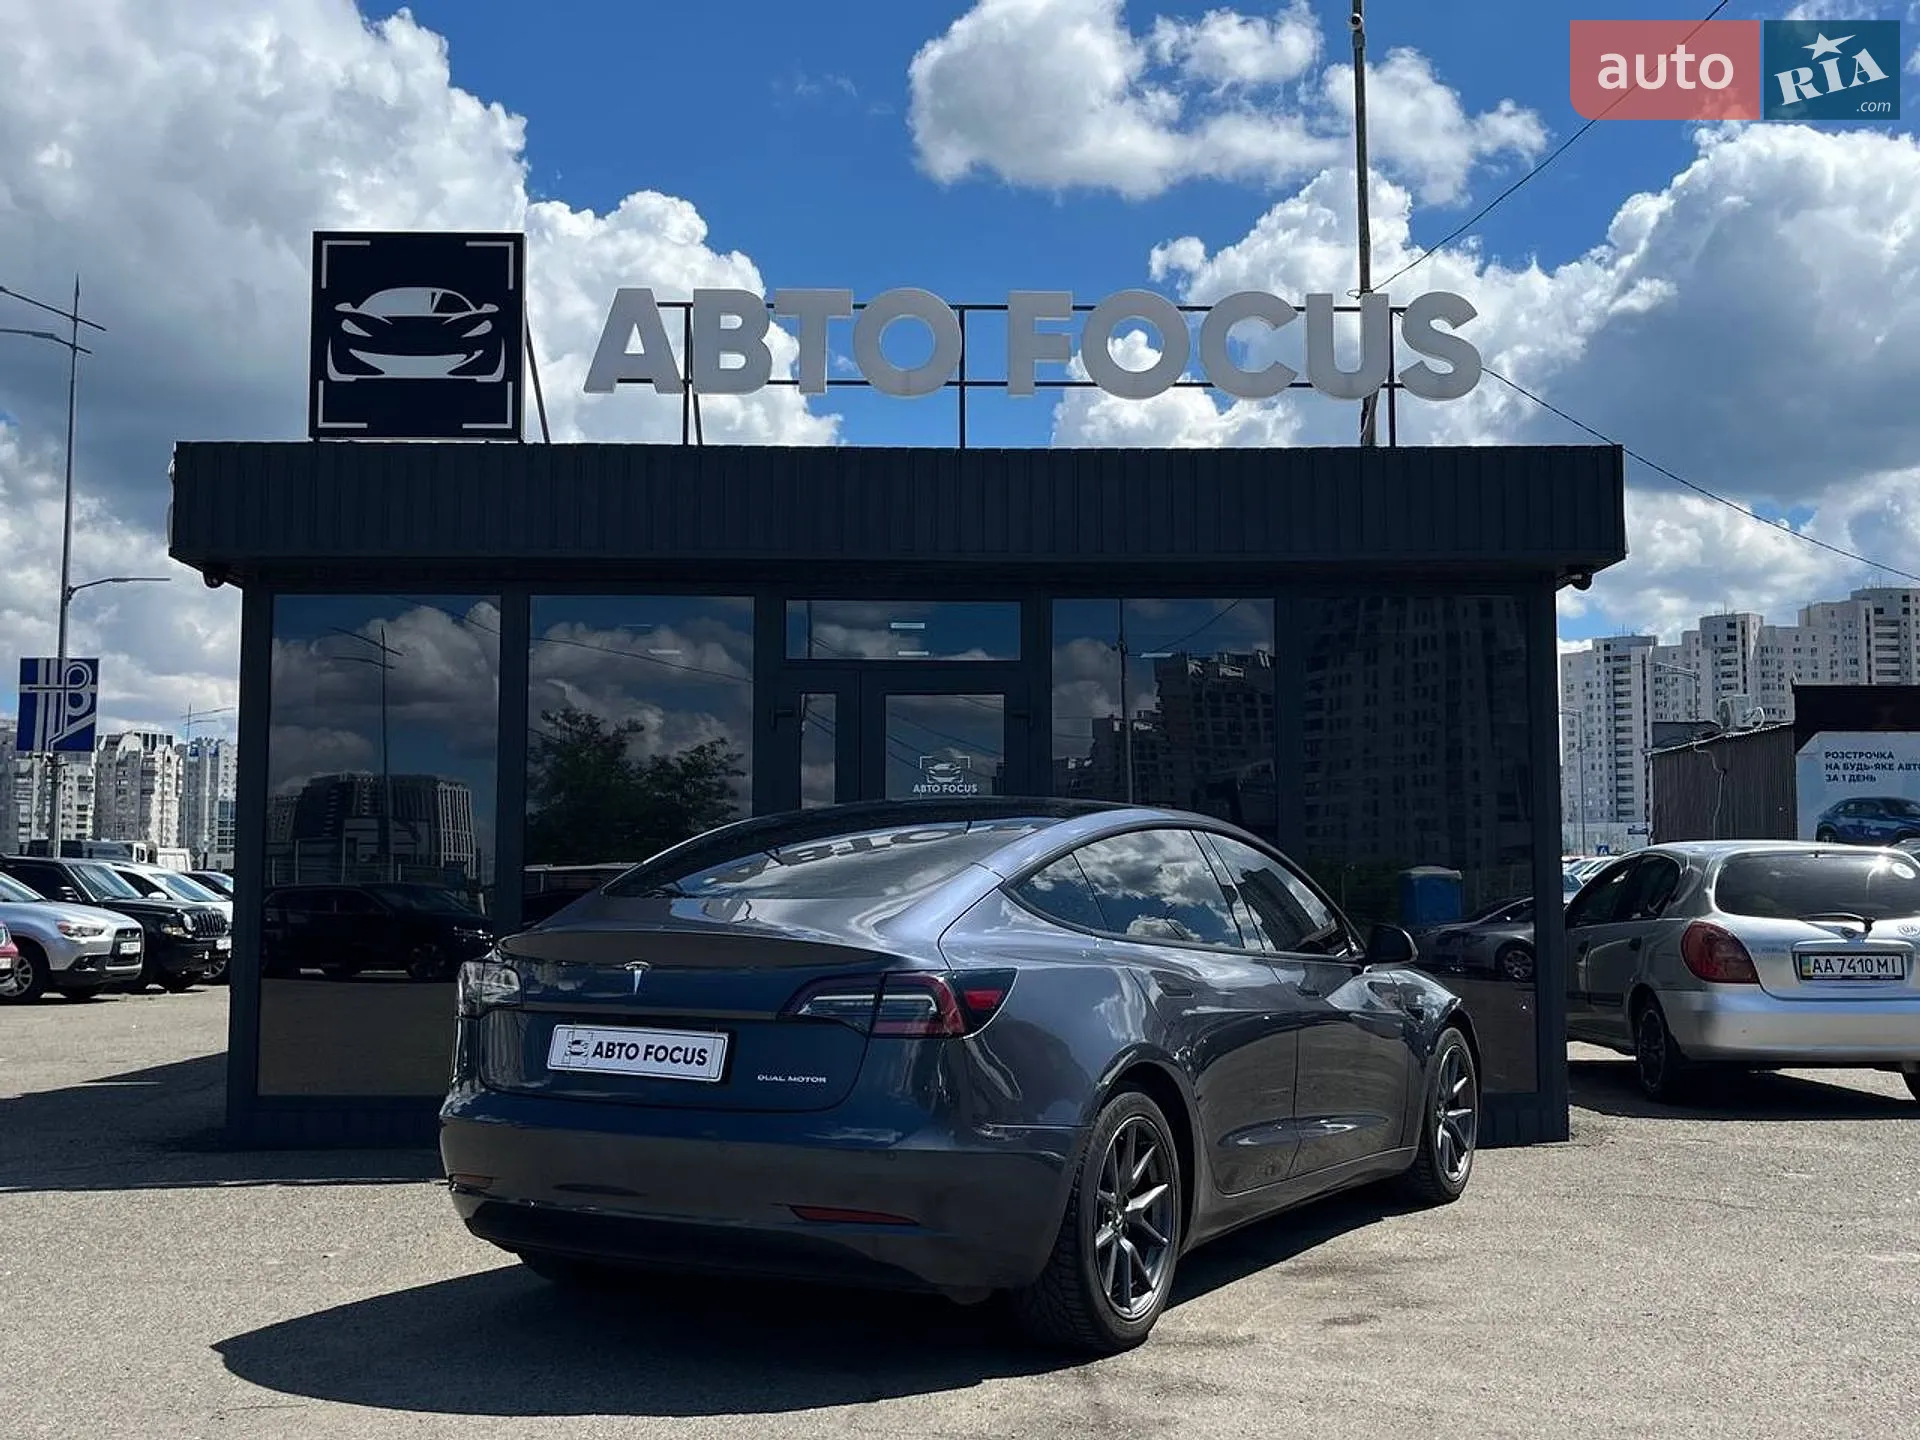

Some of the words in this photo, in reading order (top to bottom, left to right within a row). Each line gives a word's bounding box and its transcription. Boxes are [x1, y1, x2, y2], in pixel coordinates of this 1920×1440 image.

[583, 287, 963, 398] АВТО
[1006, 288, 1483, 402] FOCUS
[1824, 751, 1895, 760] РОЗСТРОЧКА
[1824, 762, 1840, 771] НА
[1824, 774, 1839, 782] ЗА
[913, 784, 940, 793] АВТО
[942, 784, 978, 793] FOCUS
[591, 1040, 640, 1060] АВТО
[643, 1043, 708, 1066] FOCUS
[757, 1073, 786, 1082] DUAL
[787, 1075, 826, 1084] MOTOR
